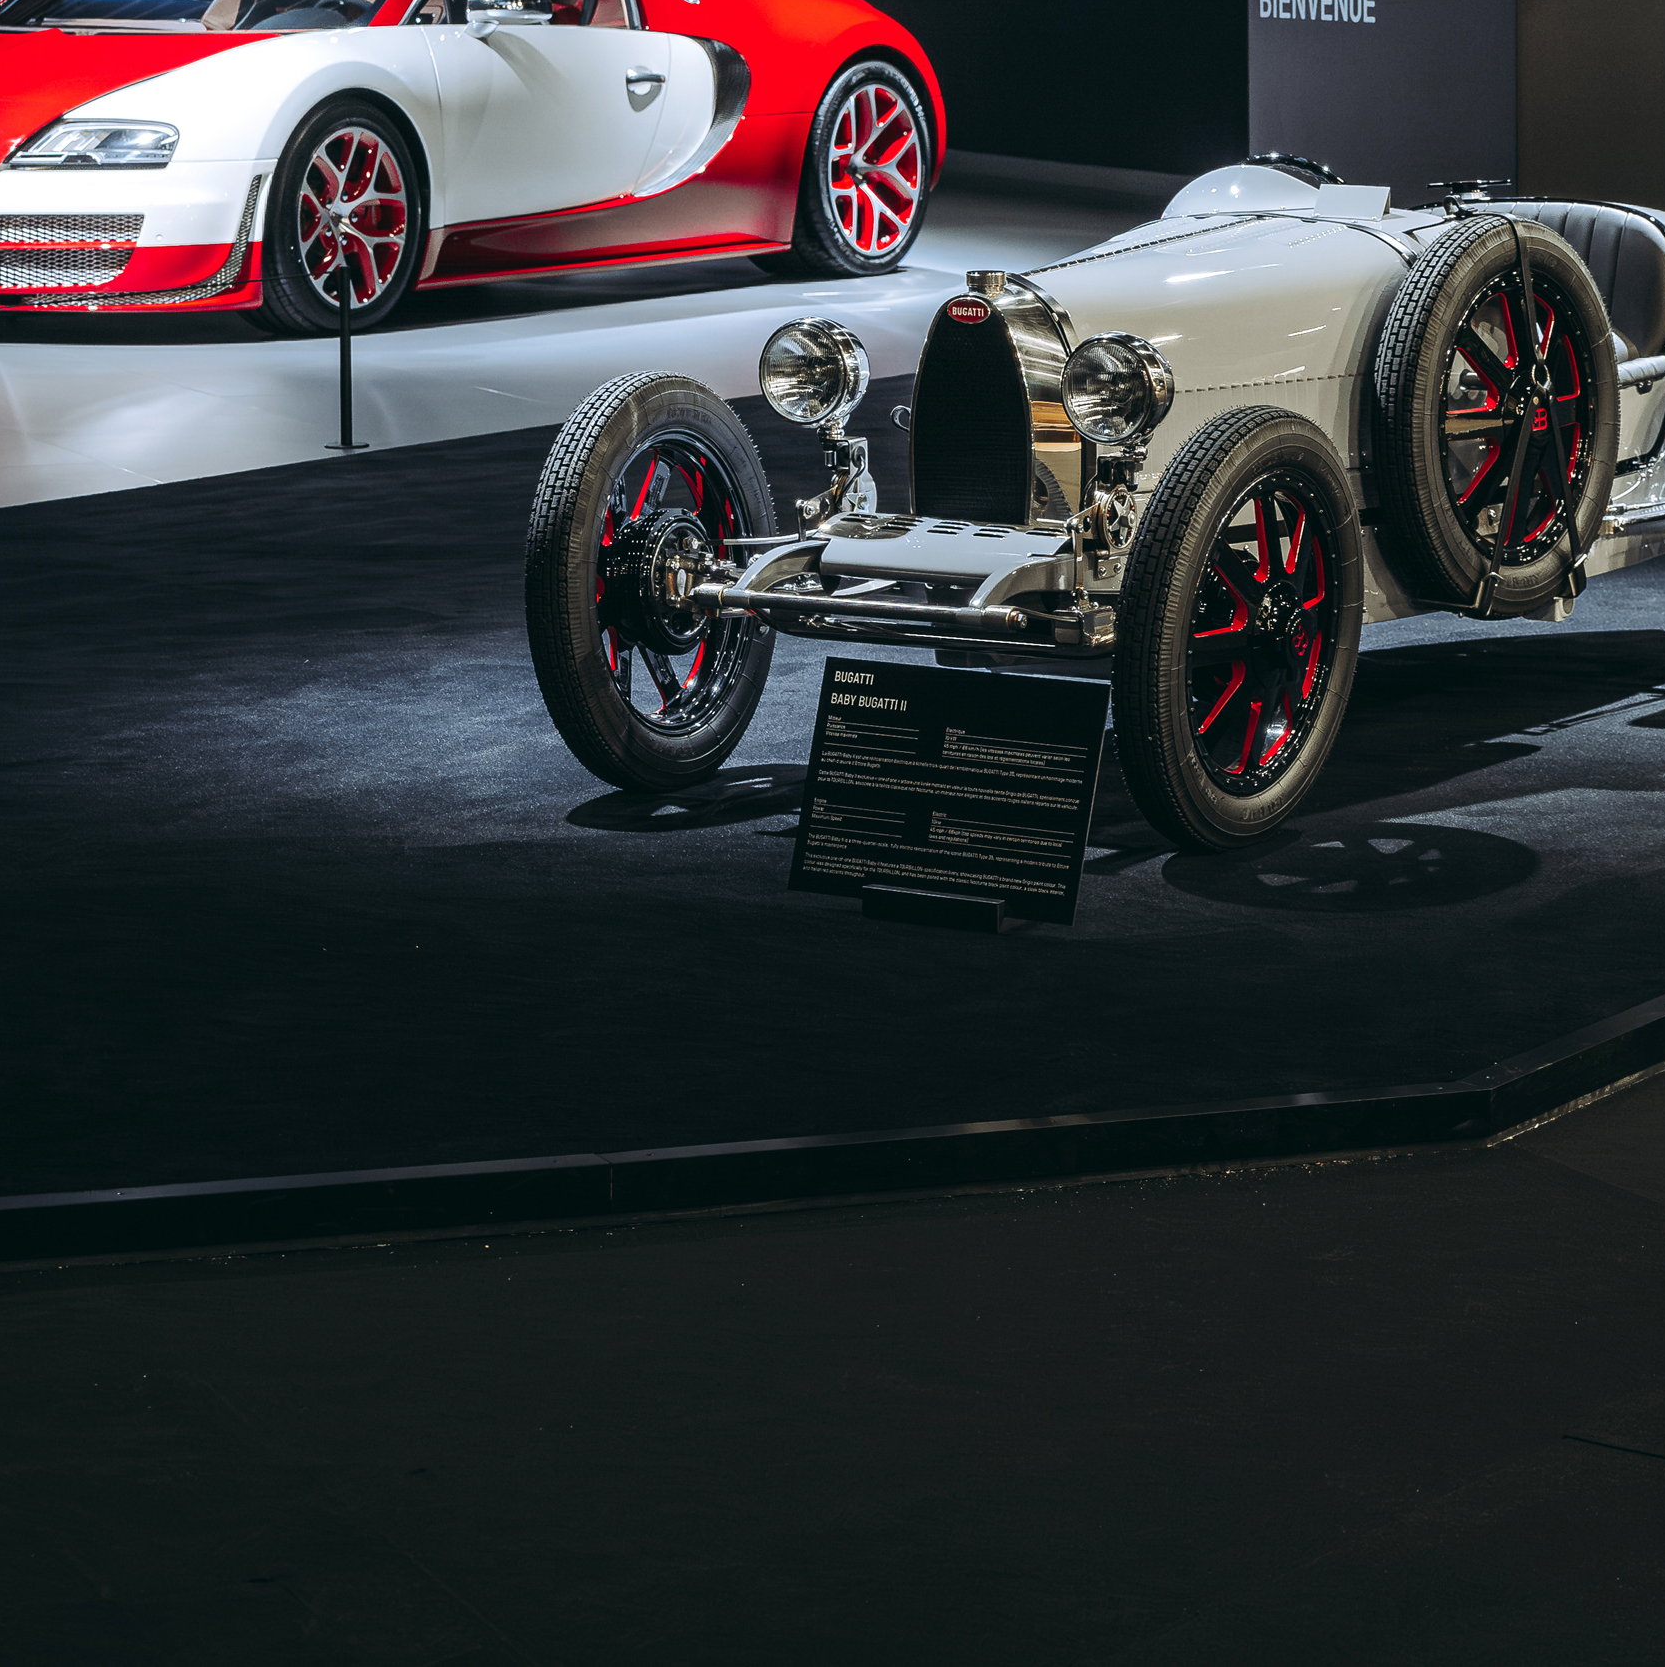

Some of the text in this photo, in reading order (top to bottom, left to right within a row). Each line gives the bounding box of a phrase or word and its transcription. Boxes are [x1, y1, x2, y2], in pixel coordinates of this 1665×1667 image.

[951, 306, 985, 317] BUGATTI
[835, 671, 874, 685] BUGATTI
[831, 692, 907, 711] BABY BUGATTI II
